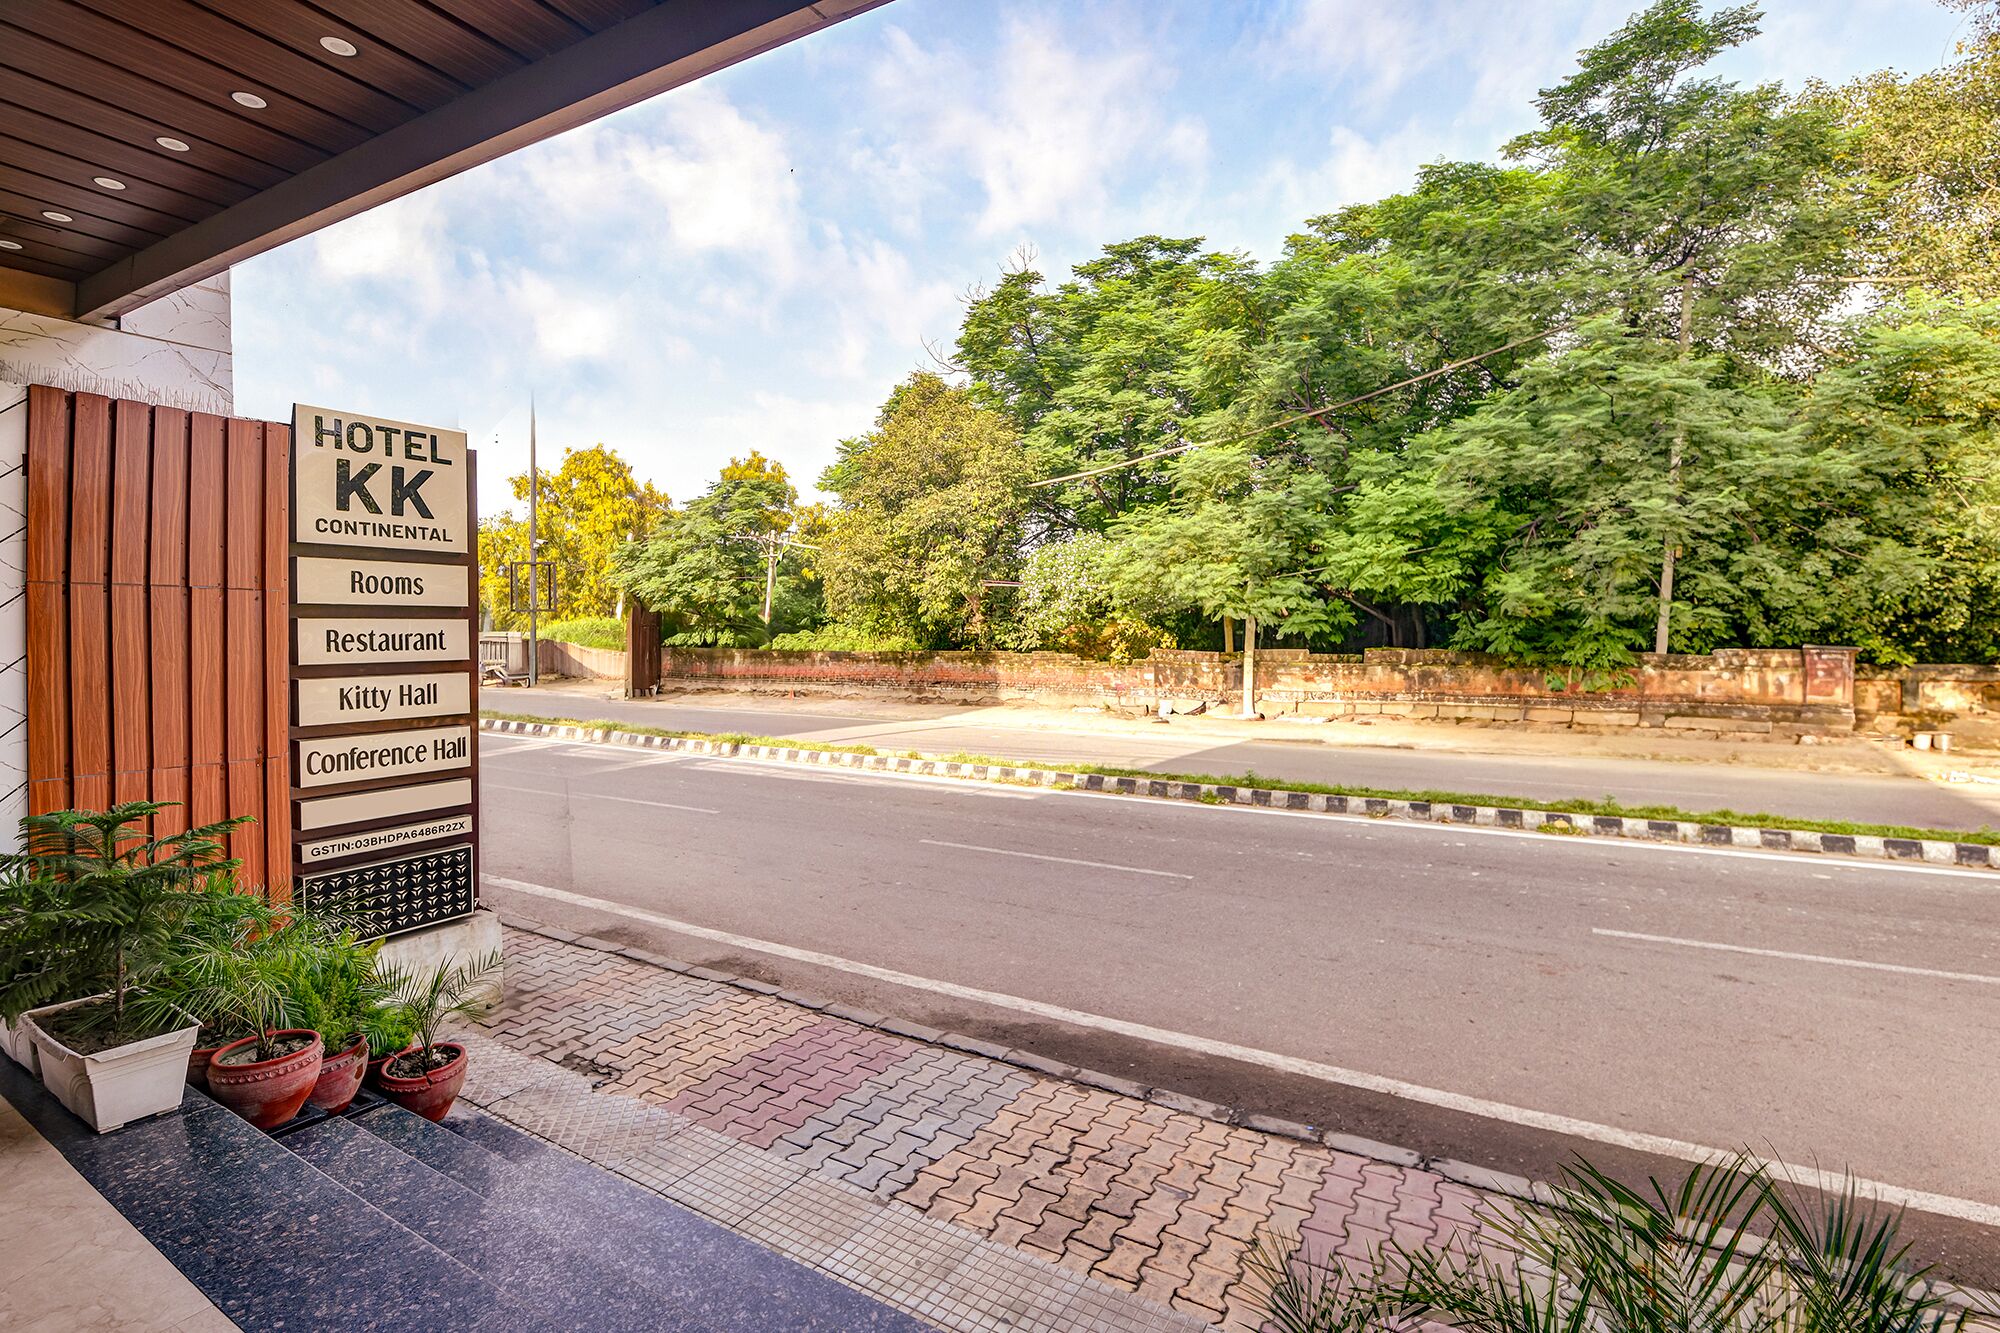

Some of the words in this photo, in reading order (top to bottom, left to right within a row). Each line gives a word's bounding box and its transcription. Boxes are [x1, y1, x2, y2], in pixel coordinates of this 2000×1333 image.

[314, 415, 452, 465] HOTEL
[336, 458, 434, 520] KK
[315, 517, 453, 542] CONTINENTAL
[350, 570, 424, 595] Rooms
[325, 628, 447, 653] Restaurant
[339, 685, 392, 712] Kitty
[399, 683, 438, 707] Hall
[306, 744, 427, 775] Conference
[433, 736, 466, 761] Hall
